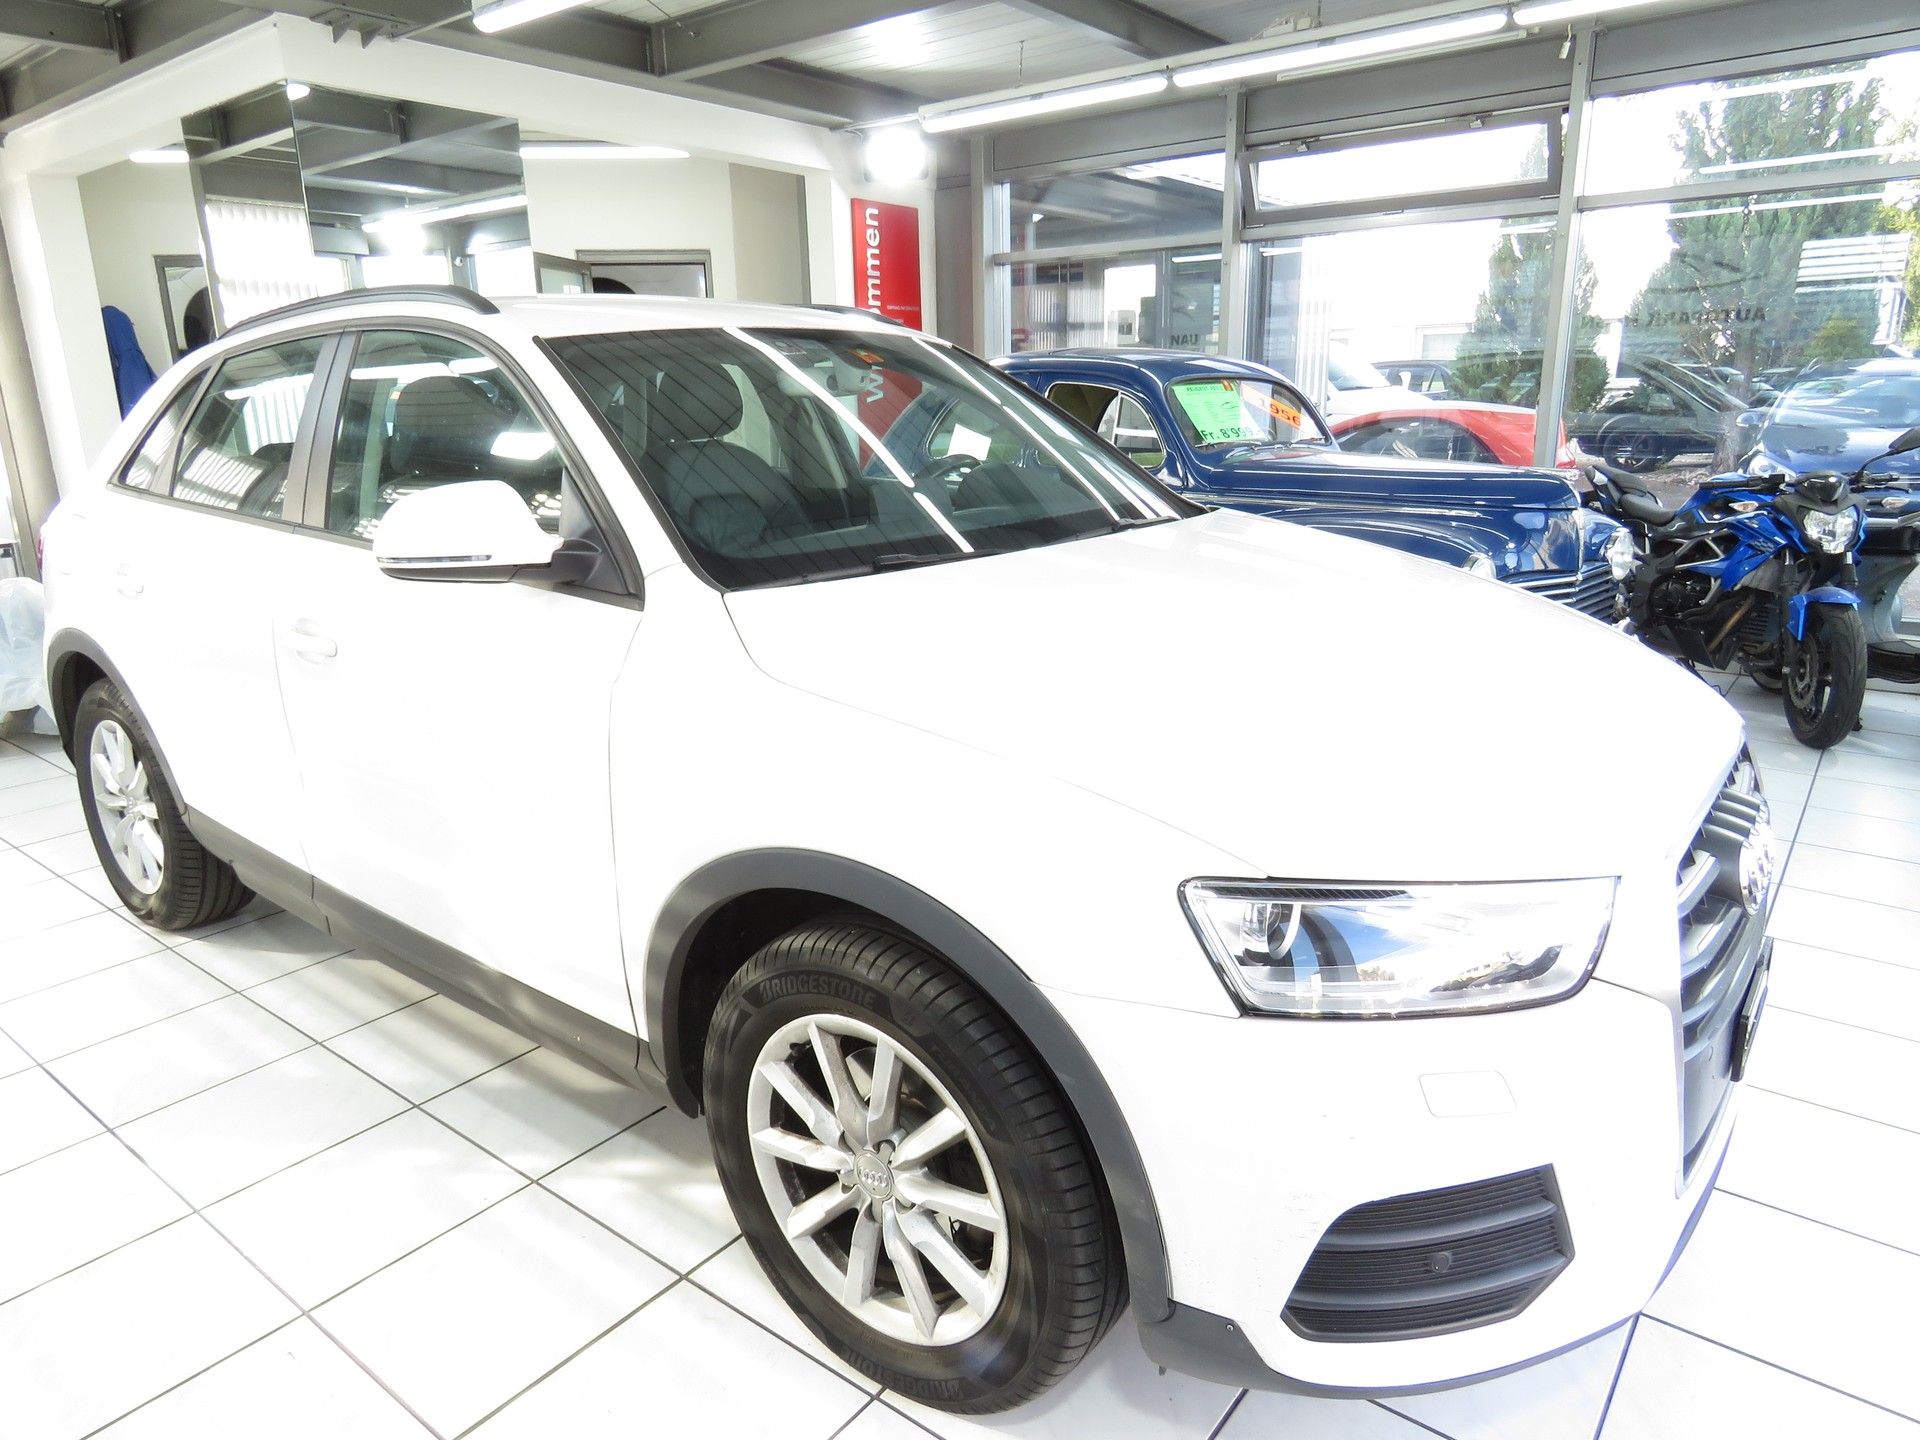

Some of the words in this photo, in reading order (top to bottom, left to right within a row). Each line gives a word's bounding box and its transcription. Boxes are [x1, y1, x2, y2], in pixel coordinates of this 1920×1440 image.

[1258, 398, 1301, 427] 1956
[1201, 430, 1220, 440] Fr.
[759, 974, 877, 1010] BRIDGESTONE
